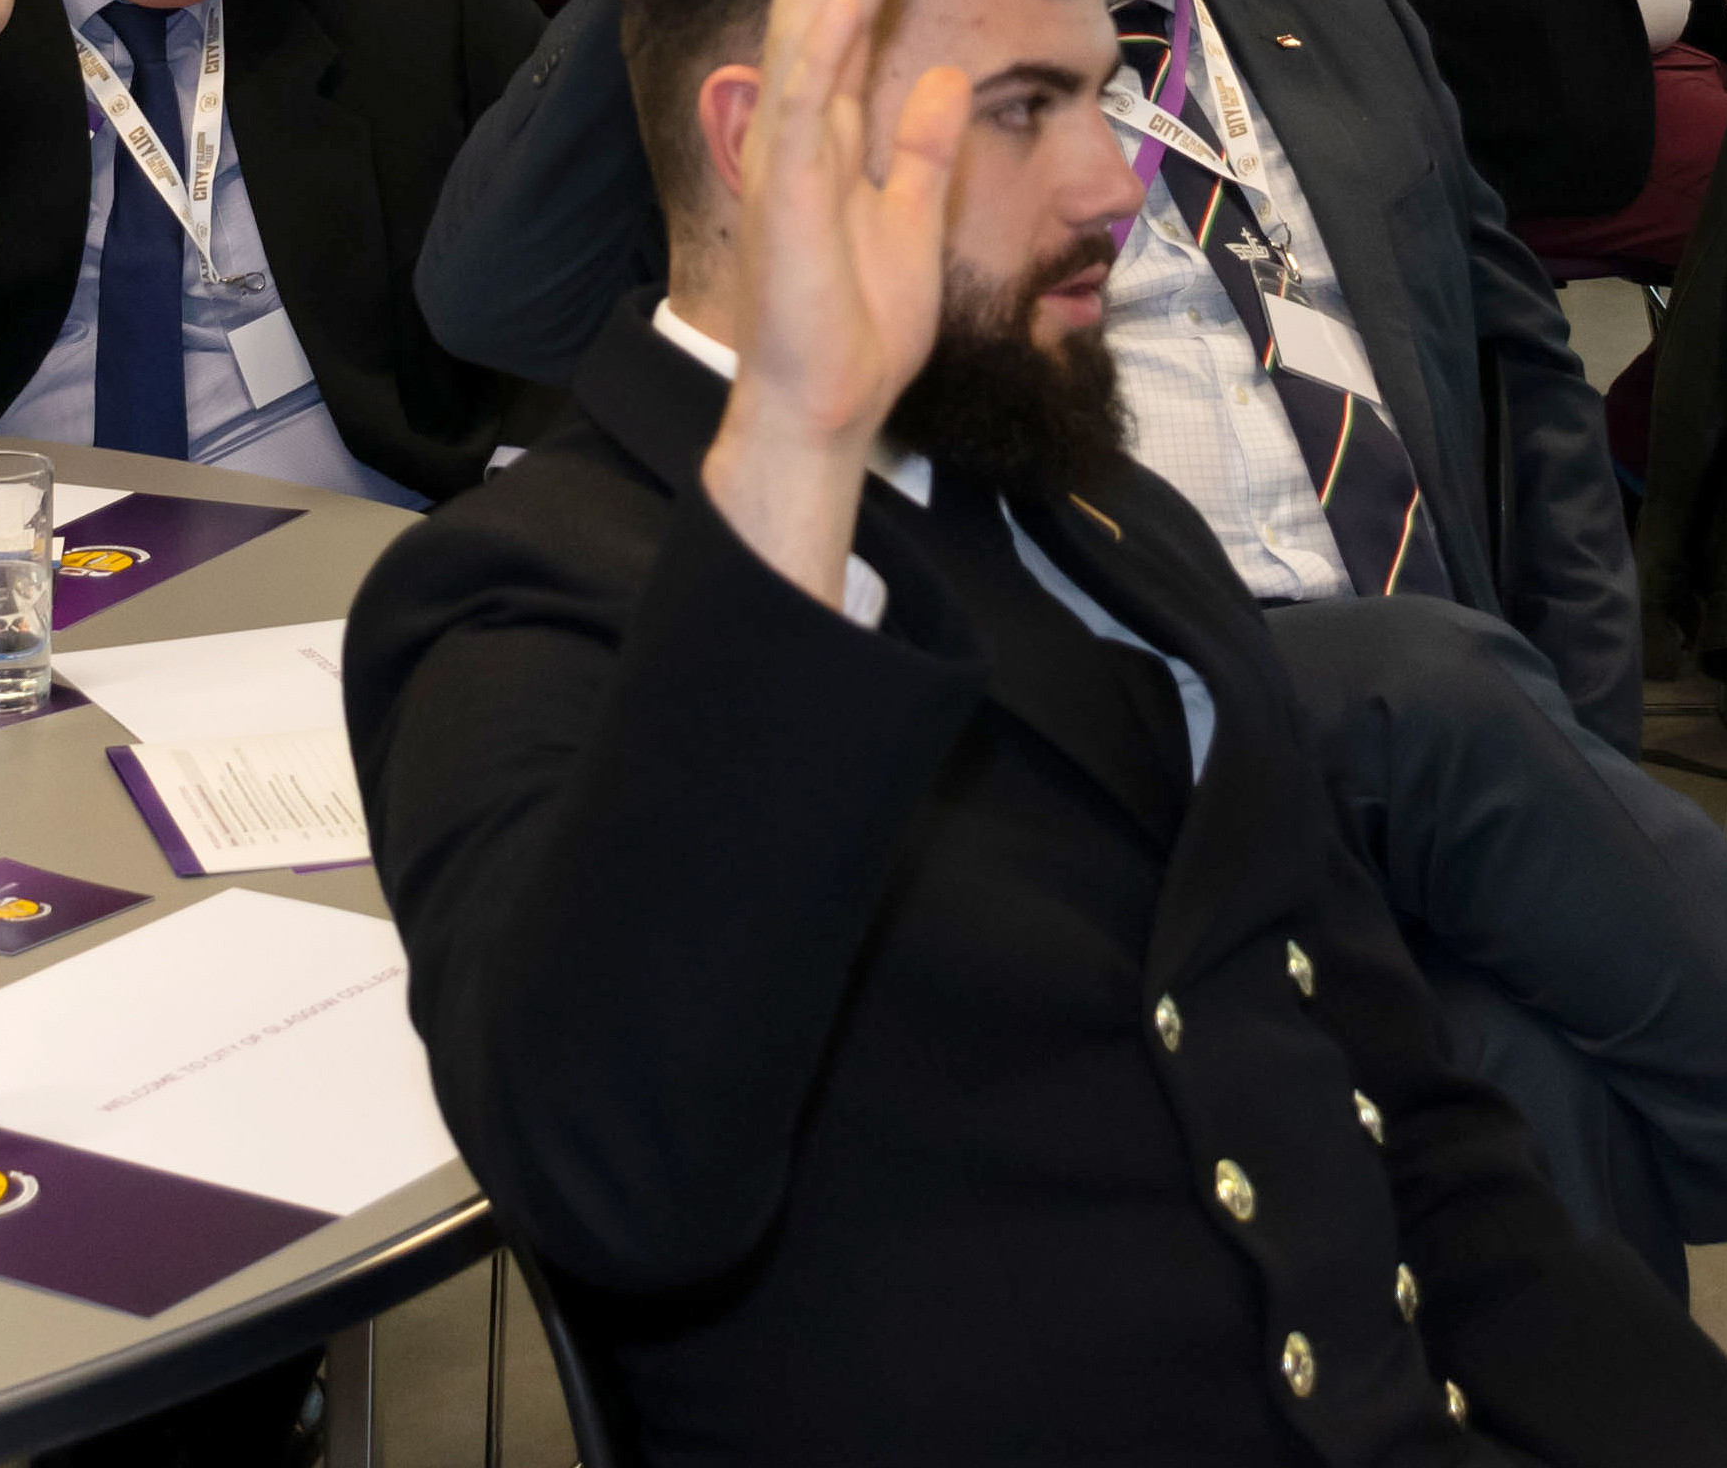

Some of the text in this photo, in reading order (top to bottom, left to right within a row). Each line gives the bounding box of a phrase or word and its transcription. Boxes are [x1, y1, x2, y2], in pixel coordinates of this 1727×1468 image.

[204, 44, 220, 74] CITY
[1149, 113, 1183, 141] CITY
[1223, 109, 1248, 139] CITY
[129, 125, 158, 157] CITY
[193, 171, 210, 201] CITY
